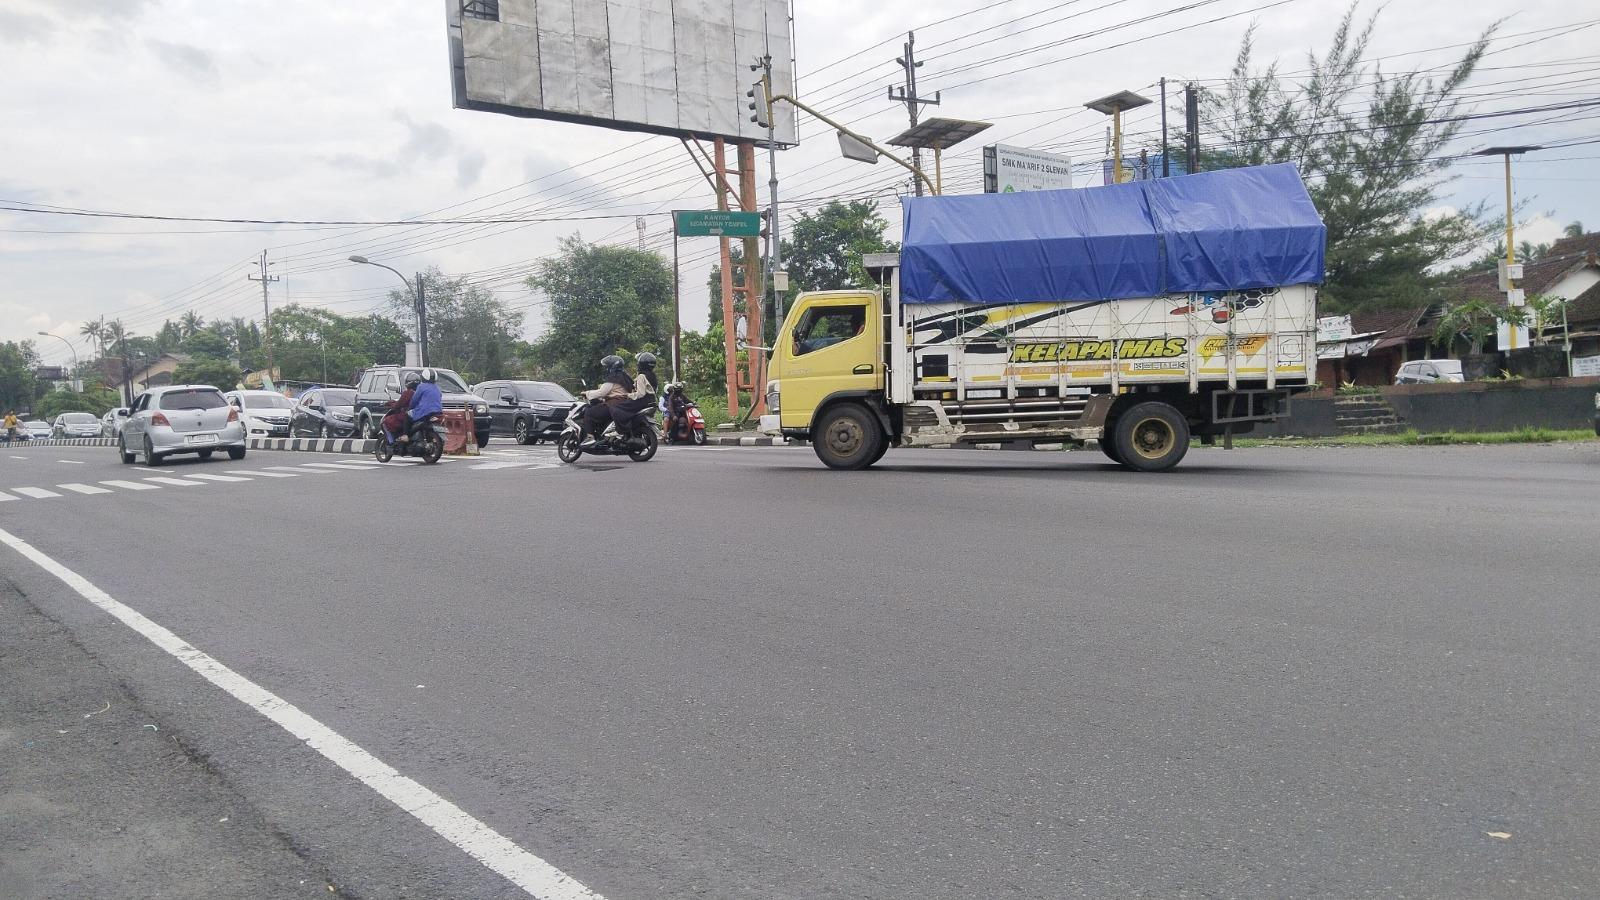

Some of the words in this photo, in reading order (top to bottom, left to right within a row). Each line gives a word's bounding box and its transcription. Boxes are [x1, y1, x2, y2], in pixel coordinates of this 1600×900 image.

[1002, 158, 1016, 168] SMK
[1041, 164, 1046, 173] 2
[1046, 164, 1069, 176] SLEMAN
[1008, 340, 1112, 363] KELAPA
[1117, 338, 1188, 360] MAS
